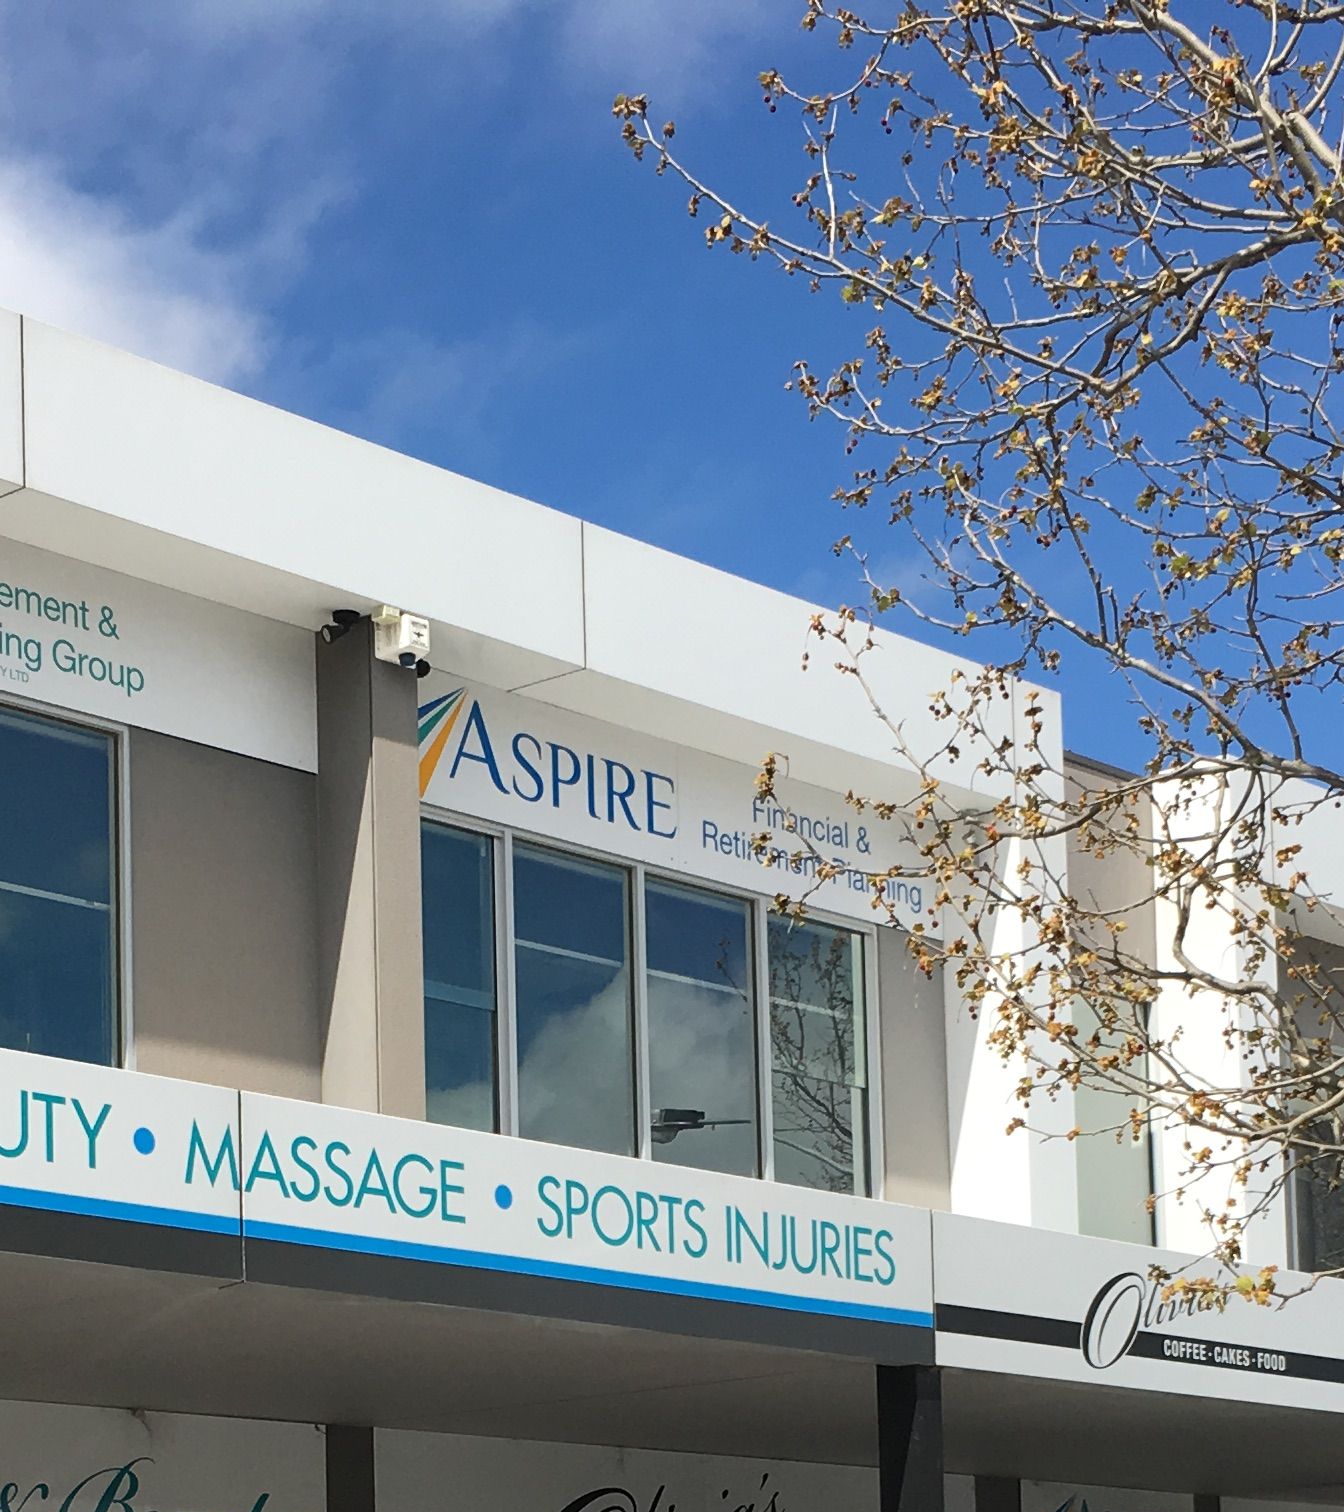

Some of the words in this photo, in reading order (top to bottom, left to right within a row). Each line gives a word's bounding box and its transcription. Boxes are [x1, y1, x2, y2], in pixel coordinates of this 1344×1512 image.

[101, 606, 120, 640] &
[9, 667, 30, 683] LTD
[52, 639, 146, 697] Group
[450, 699, 678, 839] ASPIRE
[752, 796, 849, 848] Financial
[856, 826, 871, 855] &
[185, 1118, 467, 1223] MASSAGE
[537, 1175, 708, 1258] SPORTS
[726, 1205, 896, 1286] INJURIES
[1164, 1339, 1207, 1361] COFFEE
[1214, 1346, 1250, 1367] CAKES
[1257, 1352, 1286, 1371] FOOD
